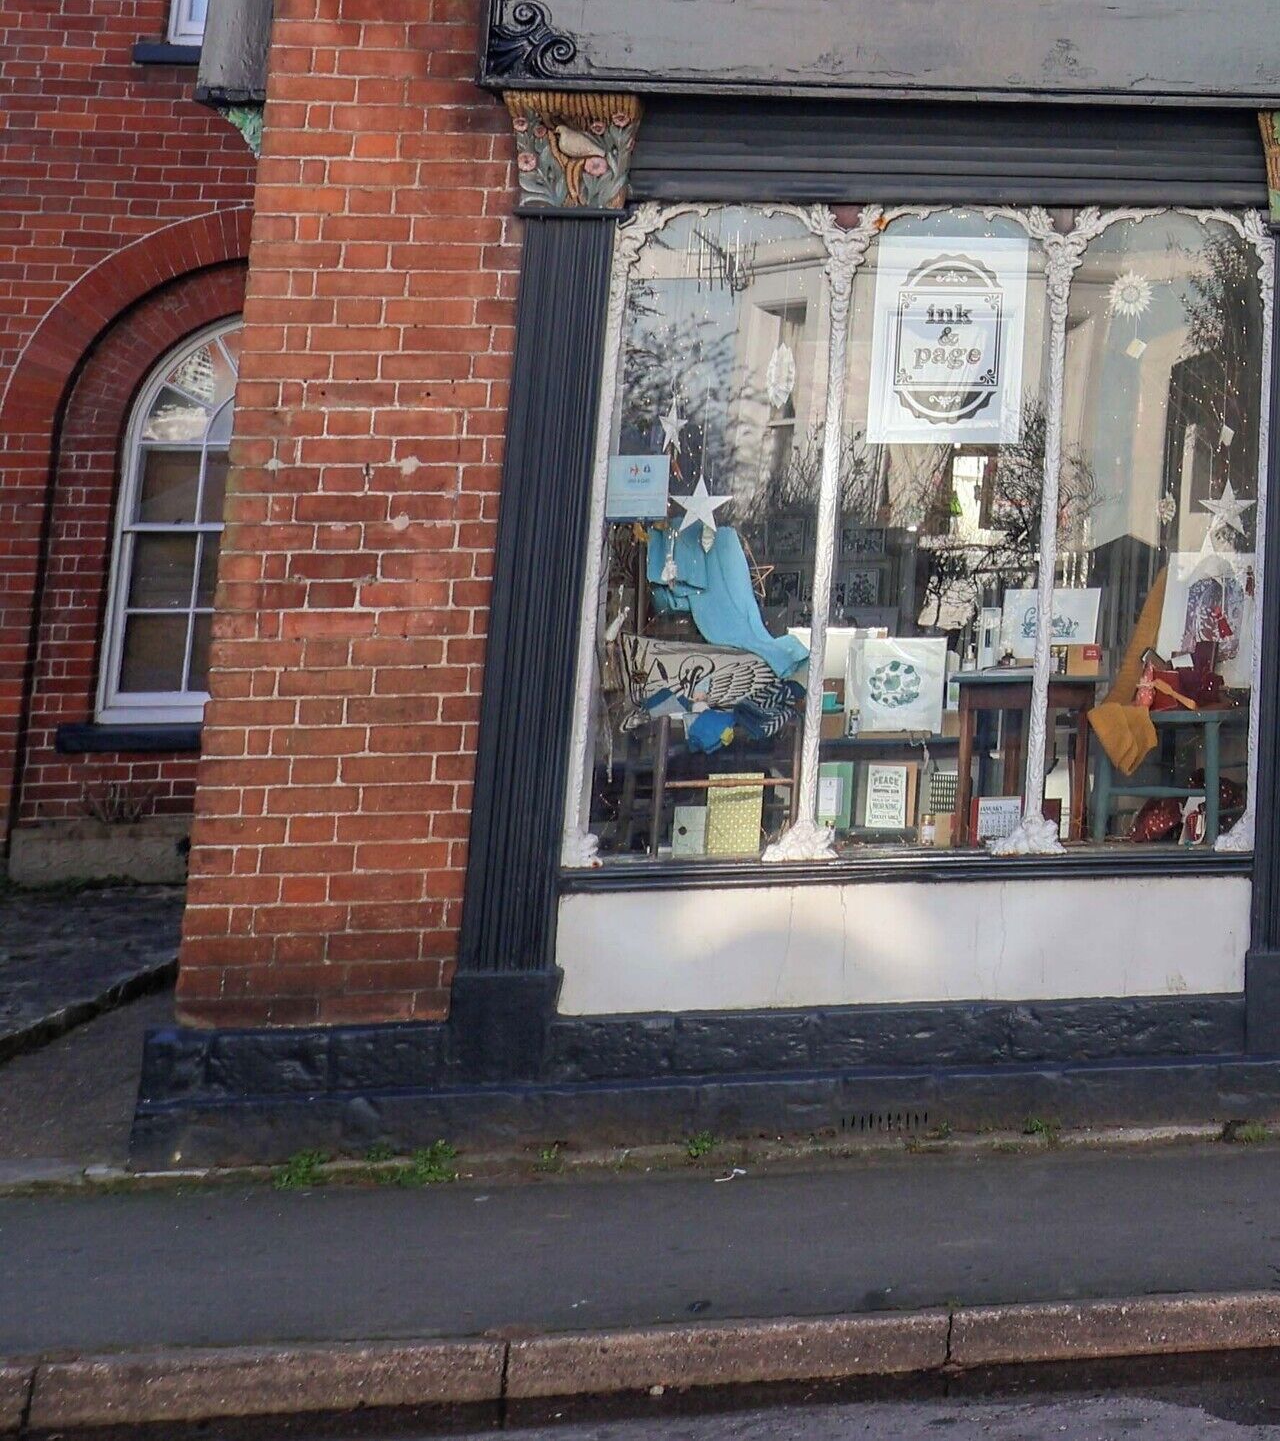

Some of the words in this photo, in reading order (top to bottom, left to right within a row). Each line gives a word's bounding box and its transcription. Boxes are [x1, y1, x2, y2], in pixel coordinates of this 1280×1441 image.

[925, 303, 974, 325] ink
[937, 326, 960, 347] &
[912, 347, 982, 370] page
